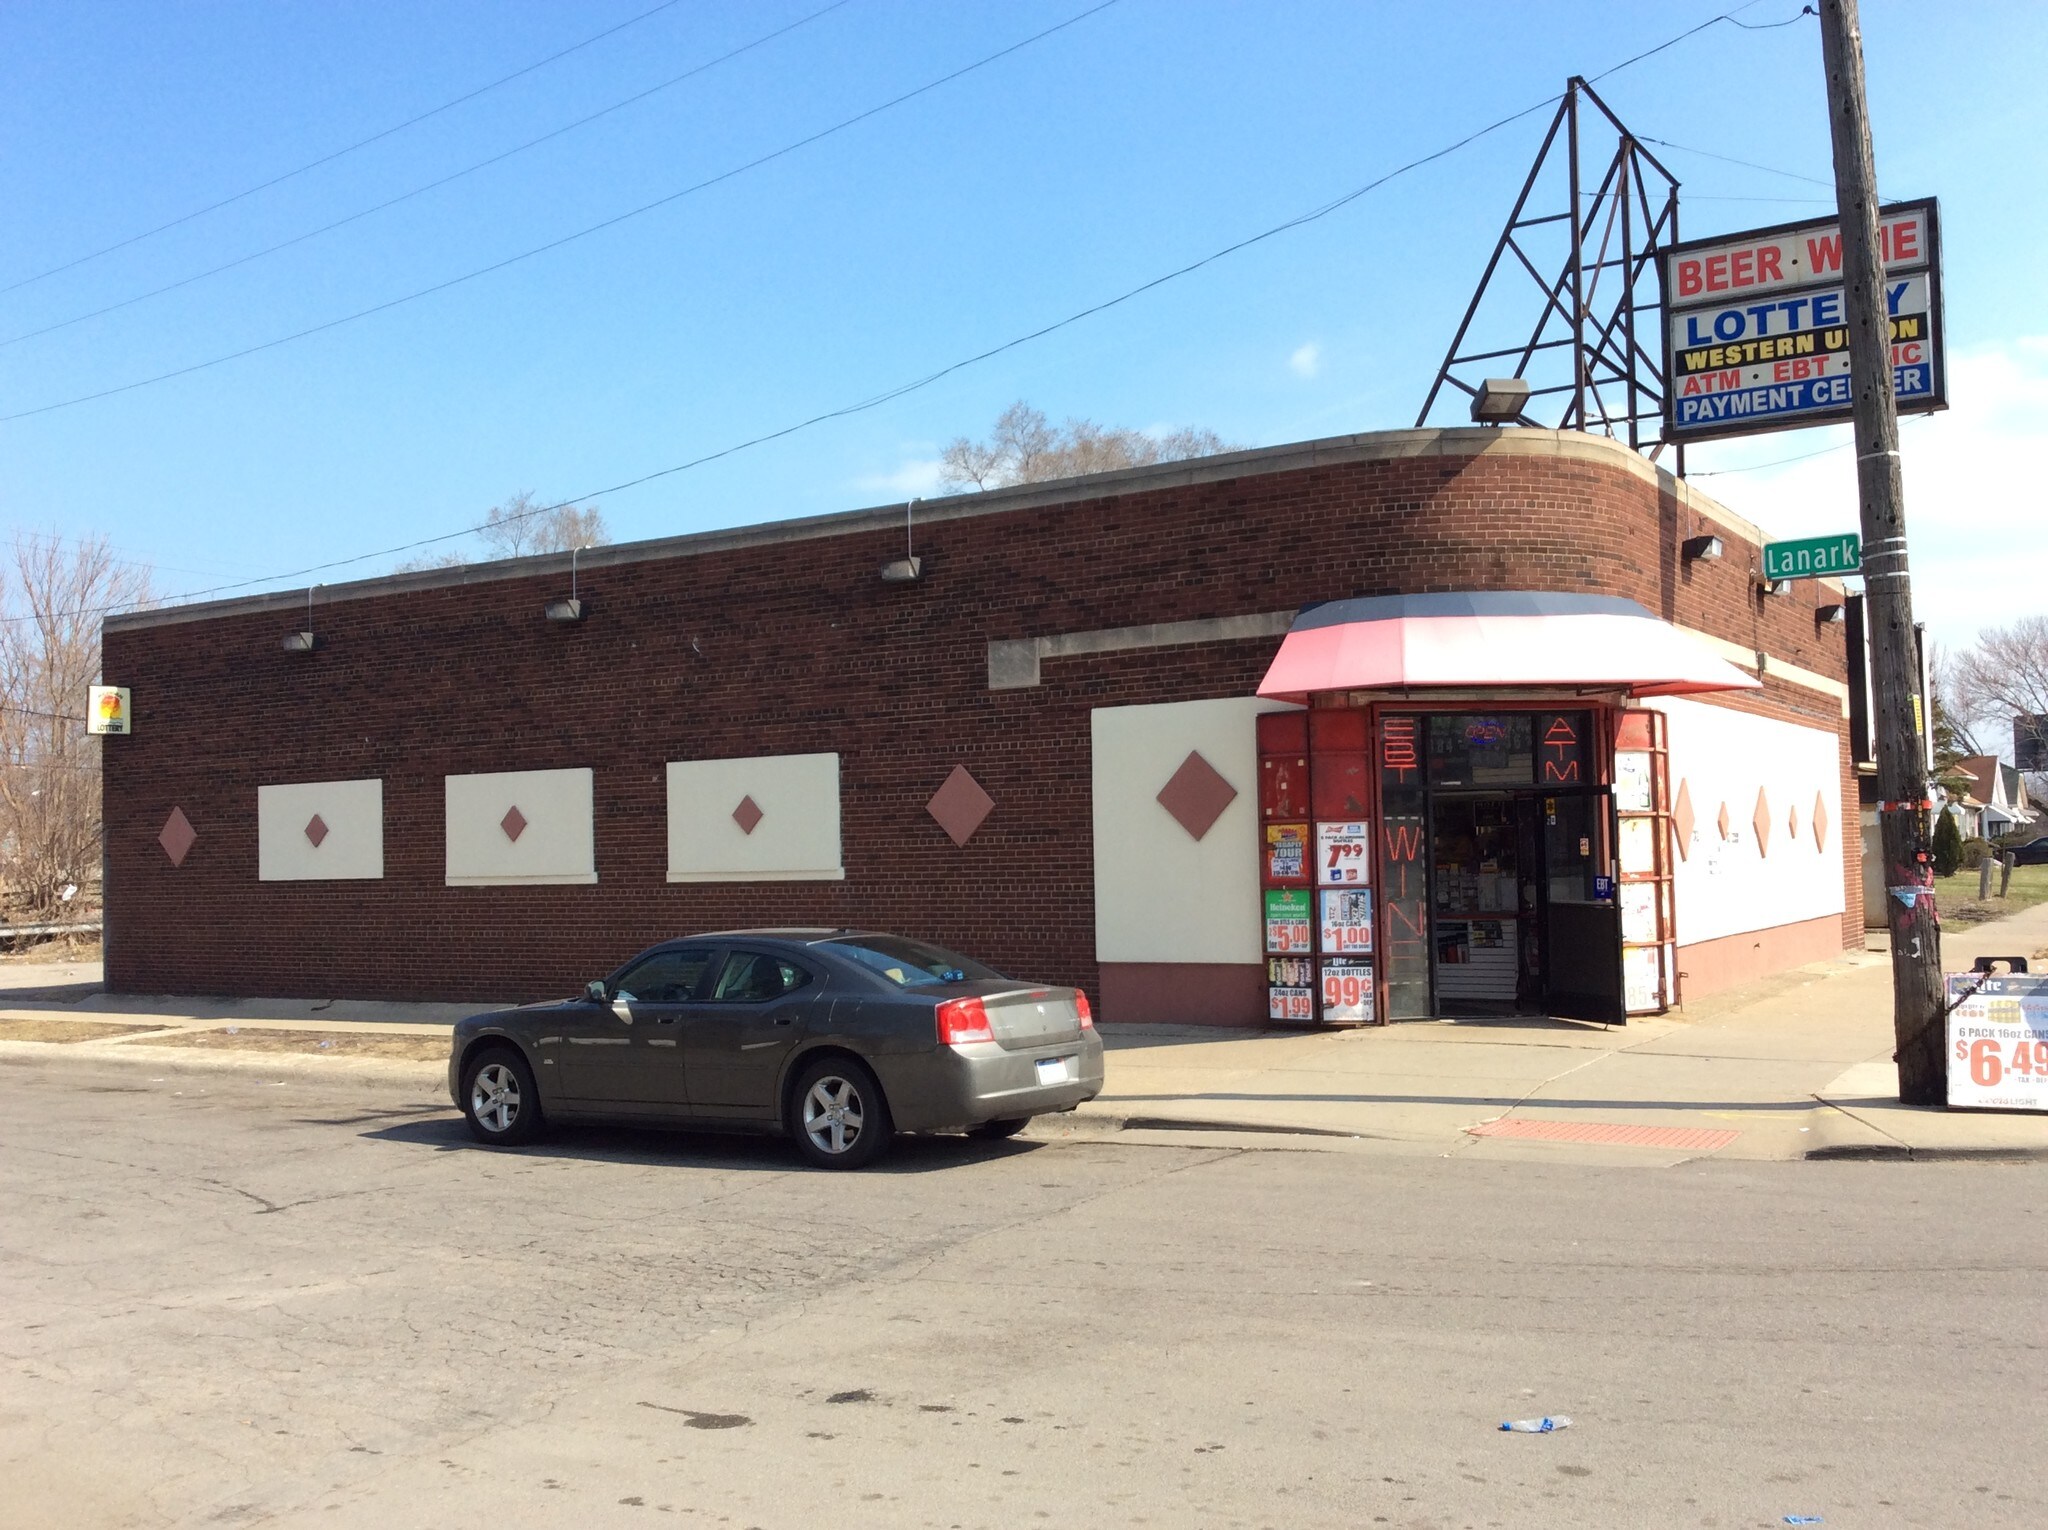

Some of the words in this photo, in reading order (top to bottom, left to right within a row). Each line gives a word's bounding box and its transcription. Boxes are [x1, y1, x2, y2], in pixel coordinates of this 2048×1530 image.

[1678, 245, 1784, 297] BEER
[1807, 221, 1918, 275] WE
[1687, 281, 1910, 347] LOTTEY
[1685, 333, 1815, 372] WESTERN
[1683, 368, 1741, 397] ATM
[1773, 355, 1830, 383] EBT
[1682, 384, 1804, 422] PAYMENT
[1811, 368, 1923, 404] CEER
[1768, 539, 1855, 574] Lanark
[97, 724, 123, 732] LOTTERY
[1465, 725, 1505, 738] OPEN
[1384, 719, 1417, 784] EBT
[1544, 717, 1577, 781] ATM
[1597, 878, 1609, 890] EBT
[1270, 903, 1306, 911] Heineken
[1272, 925, 1309, 951] $5.00
[1324, 927, 1370, 951] $1.00
[1272, 996, 1310, 1019] $1.99
[1959, 1028, 1966, 1037] 6
[1969, 1028, 1996, 1038] PACK
[1998, 1029, 2021, 1039] 16oz
[1956, 1039, 2048, 1087] $6.49
